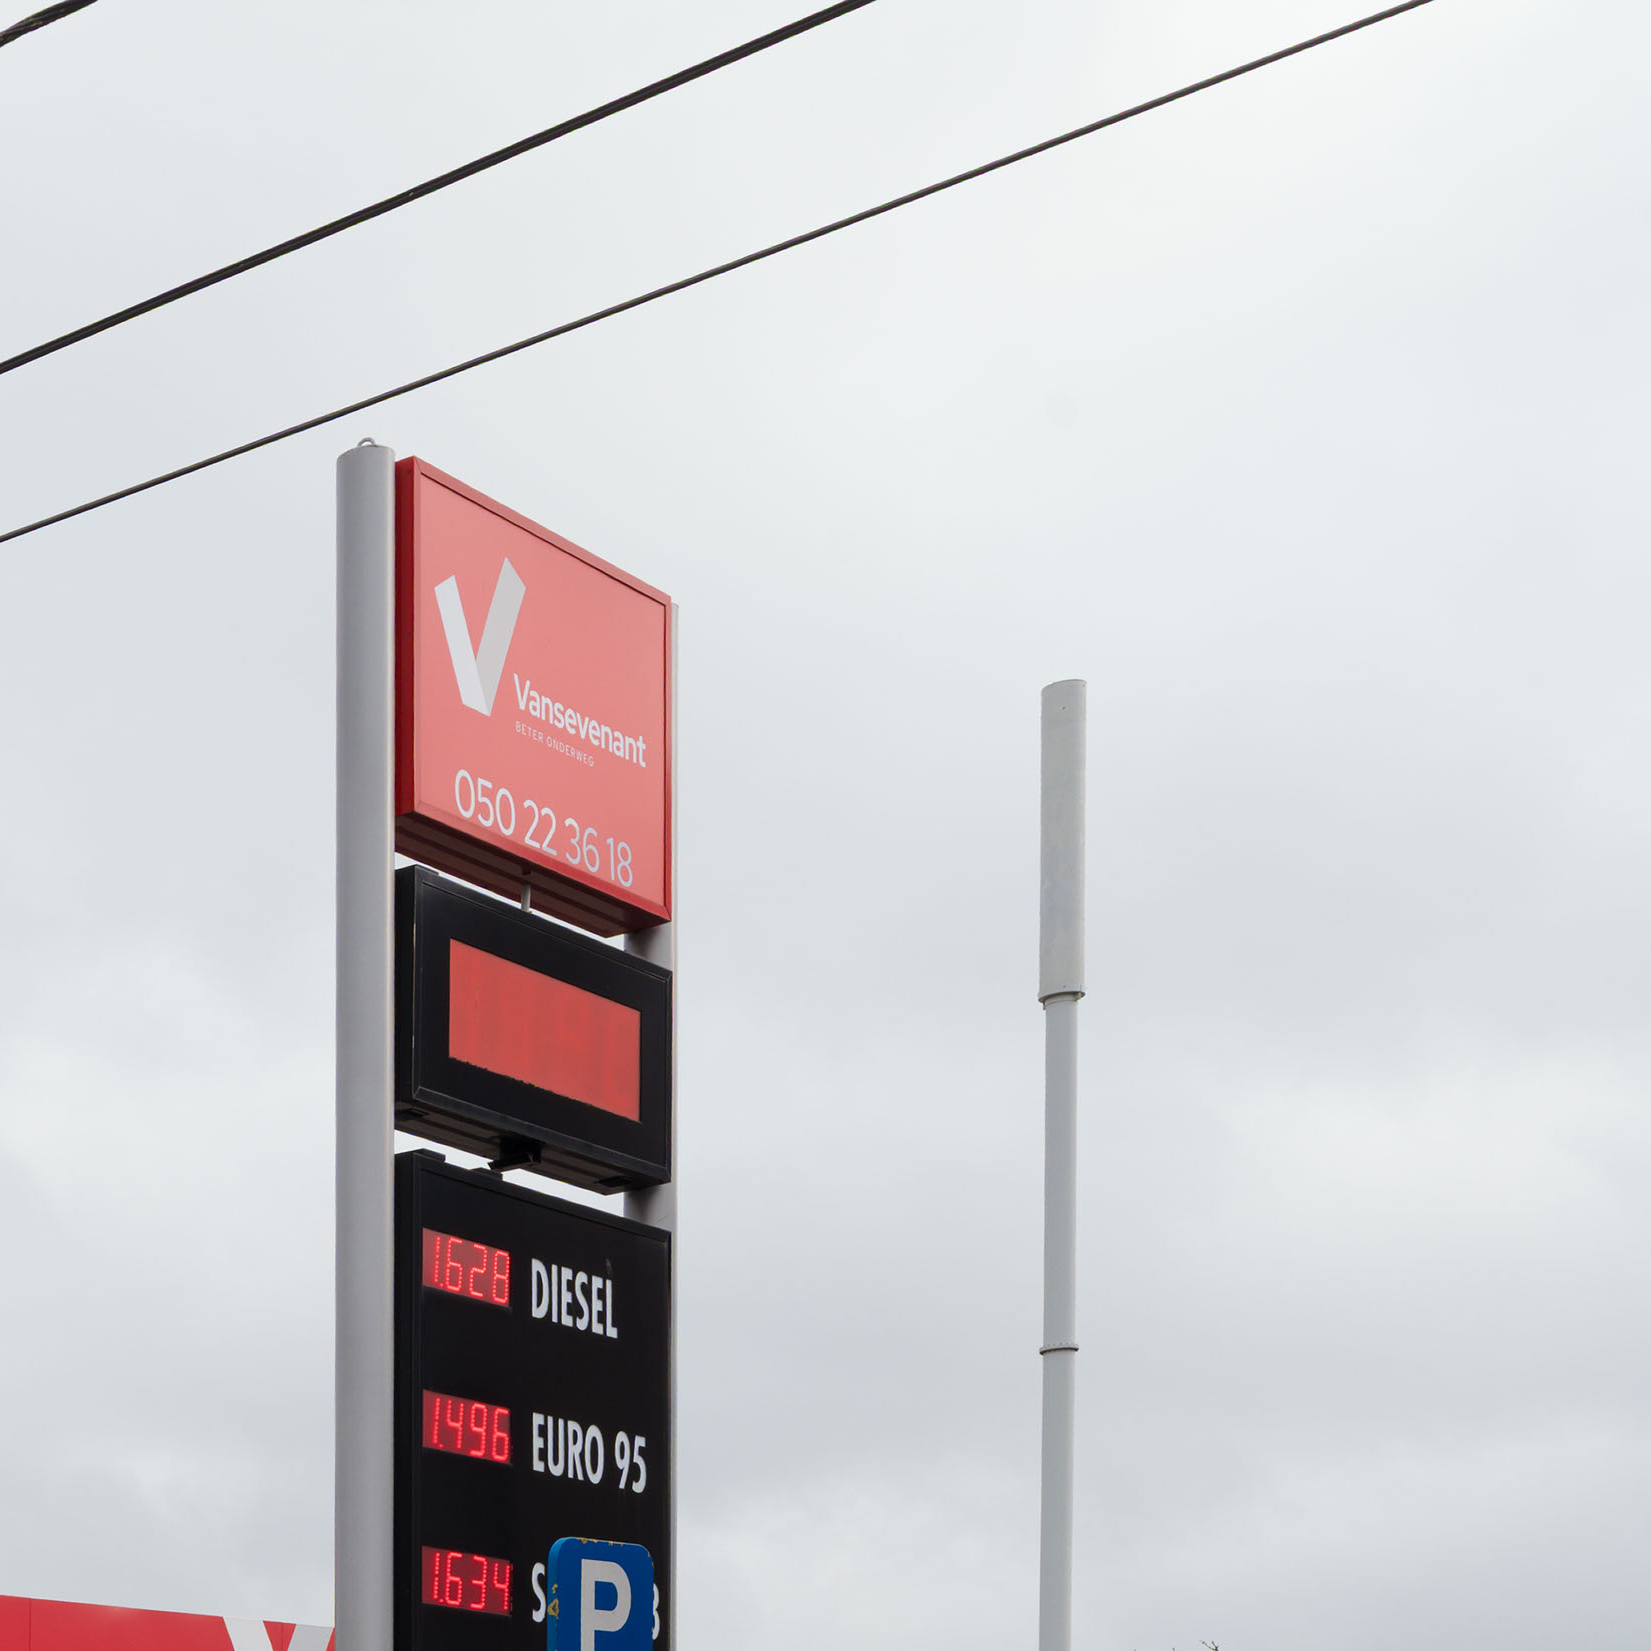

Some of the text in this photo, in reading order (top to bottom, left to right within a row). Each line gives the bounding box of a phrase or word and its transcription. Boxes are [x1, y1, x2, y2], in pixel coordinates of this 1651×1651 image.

[513, 673, 646, 768] Vansevenant
[515, 720, 595, 767] BETER ONDERWEG
[455, 769, 633, 887] 050 22 36 18
[433, 1235, 511, 1304] 1.628
[531, 1257, 618, 1338] DIESEL
[432, 1396, 510, 1461] 1.496
[532, 1412, 648, 1493] EURO 95
[433, 1551, 511, 1611] 1.634
